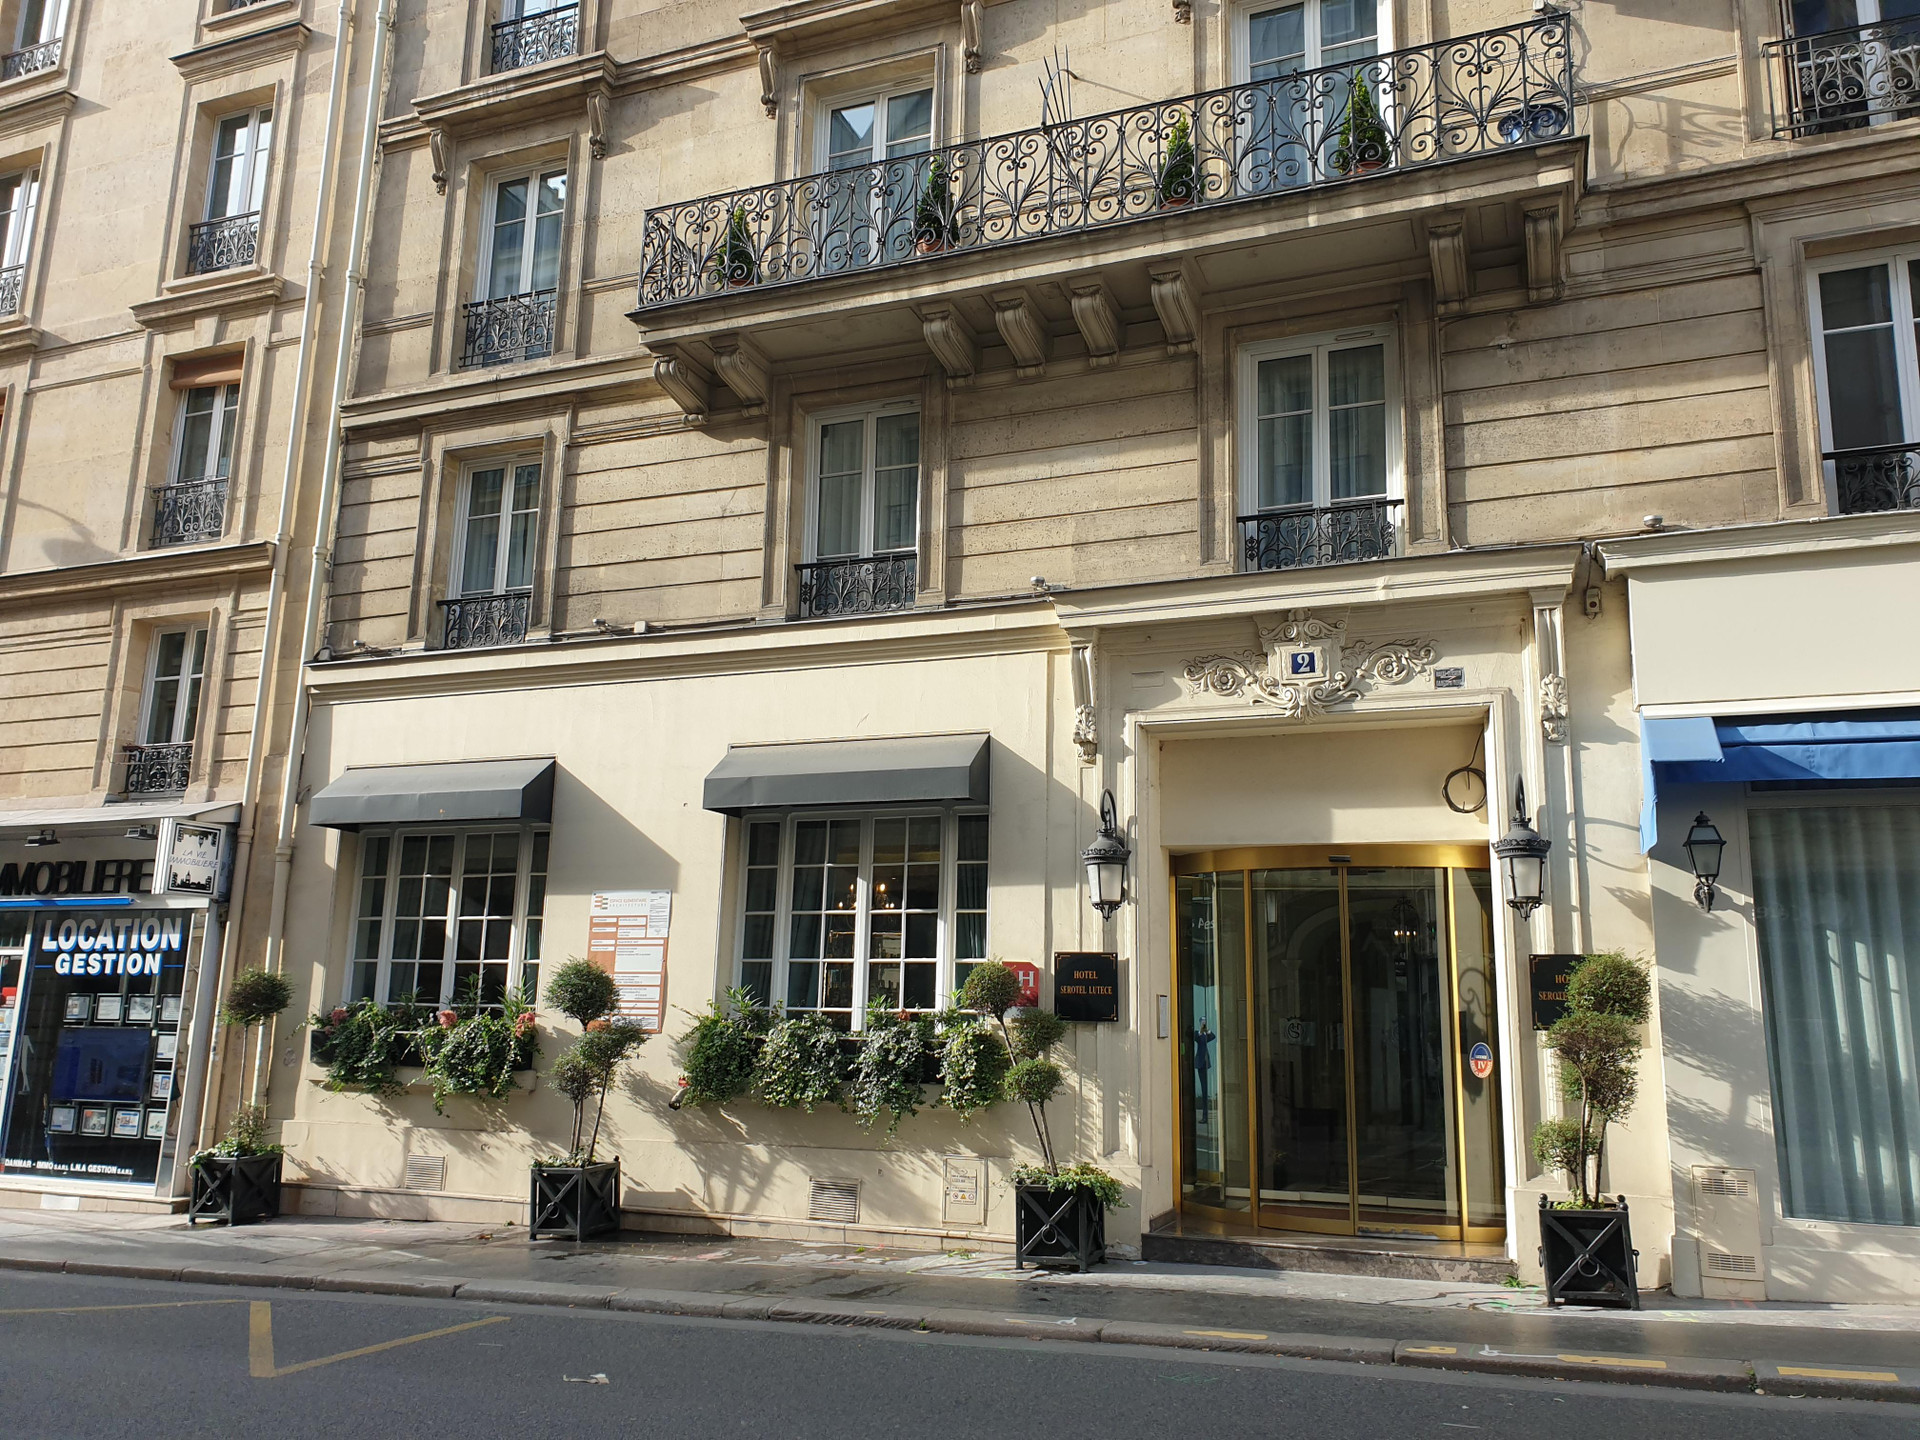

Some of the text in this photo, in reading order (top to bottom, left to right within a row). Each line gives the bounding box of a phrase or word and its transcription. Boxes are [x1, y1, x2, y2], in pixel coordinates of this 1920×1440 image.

[1296, 653, 1310, 673] 2
[182, 849, 208, 859] LA VIE
[41, 917, 182, 952] LOCATION
[55, 952, 162, 976] GESTION
[1018, 970, 1035, 988] H
[1073, 970, 1098, 979] HOTEL
[1060, 985, 1113, 995] SEROTEL LUTECE
[87, 1164, 118, 1175] GESTION
